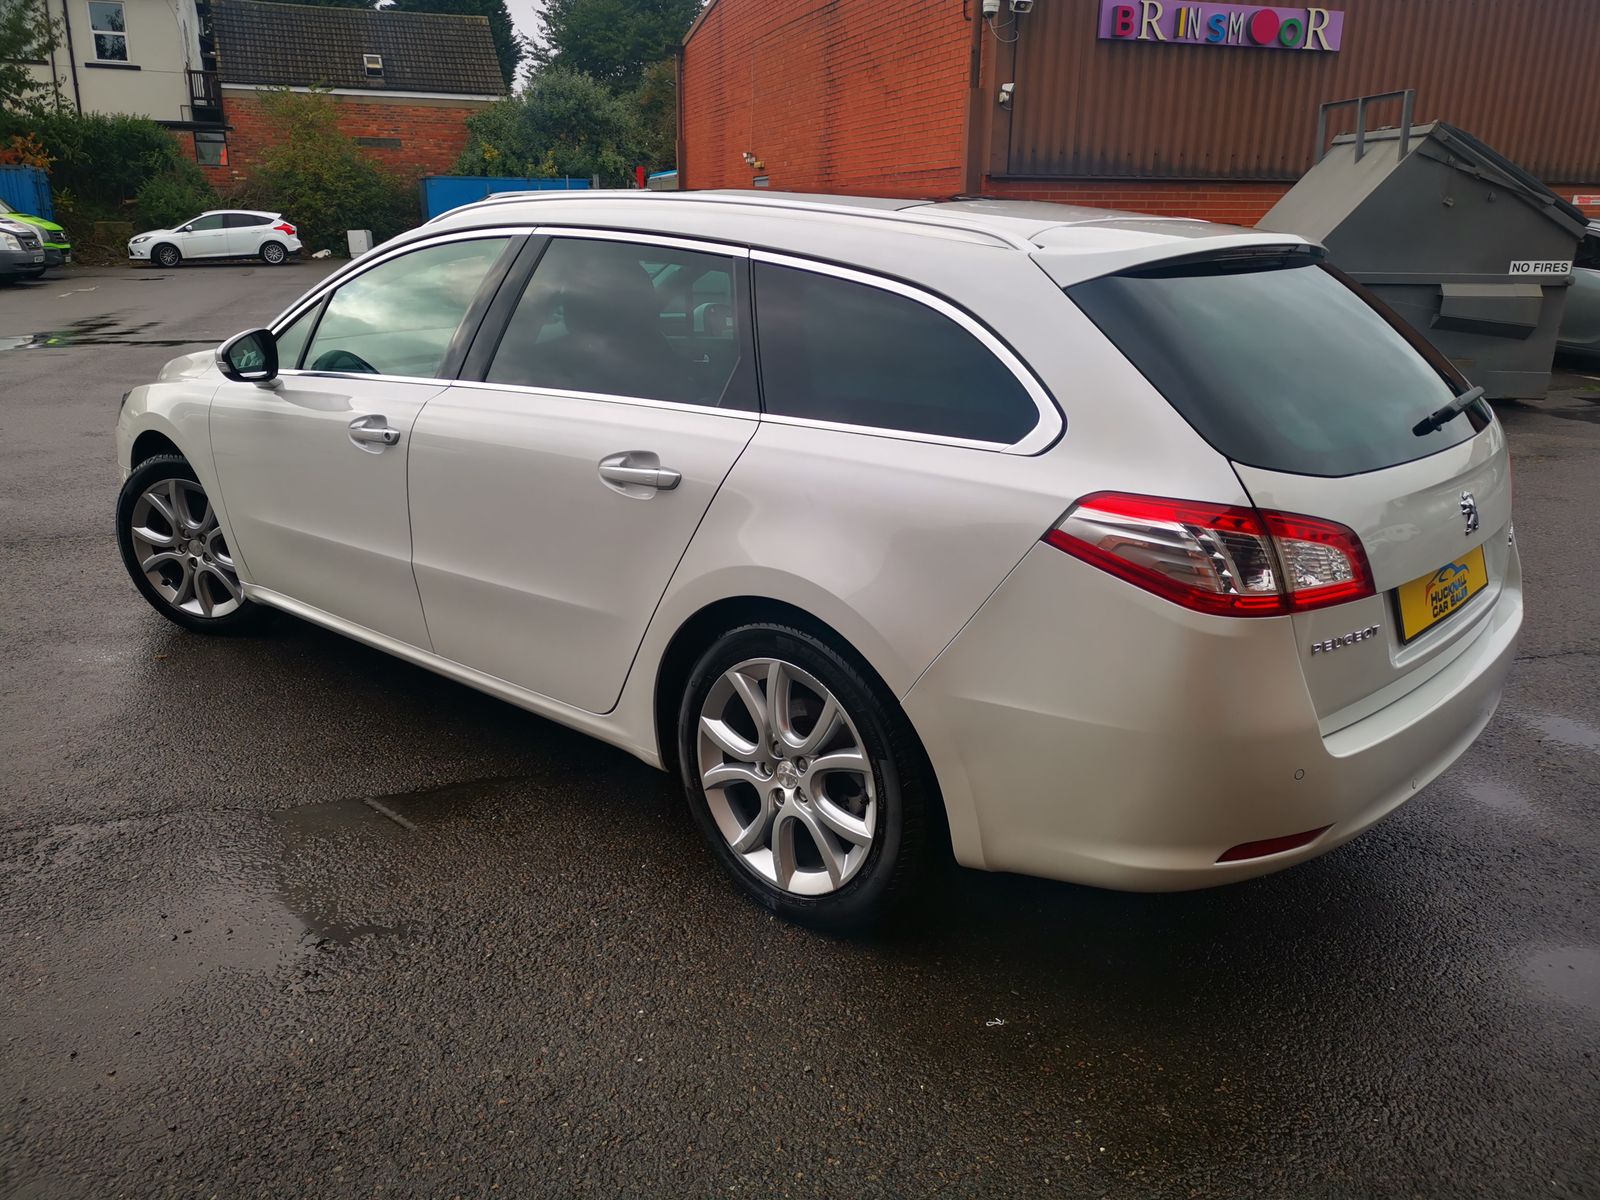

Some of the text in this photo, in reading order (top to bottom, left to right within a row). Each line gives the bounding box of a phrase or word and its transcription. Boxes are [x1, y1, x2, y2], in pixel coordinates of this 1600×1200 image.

[1112, 0, 1333, 50] BRINSMOOR
[1511, 263, 1569, 273] NO FIRES
[1432, 600, 1448, 618] CAR
[1311, 624, 1380, 656] PEUGEOT
